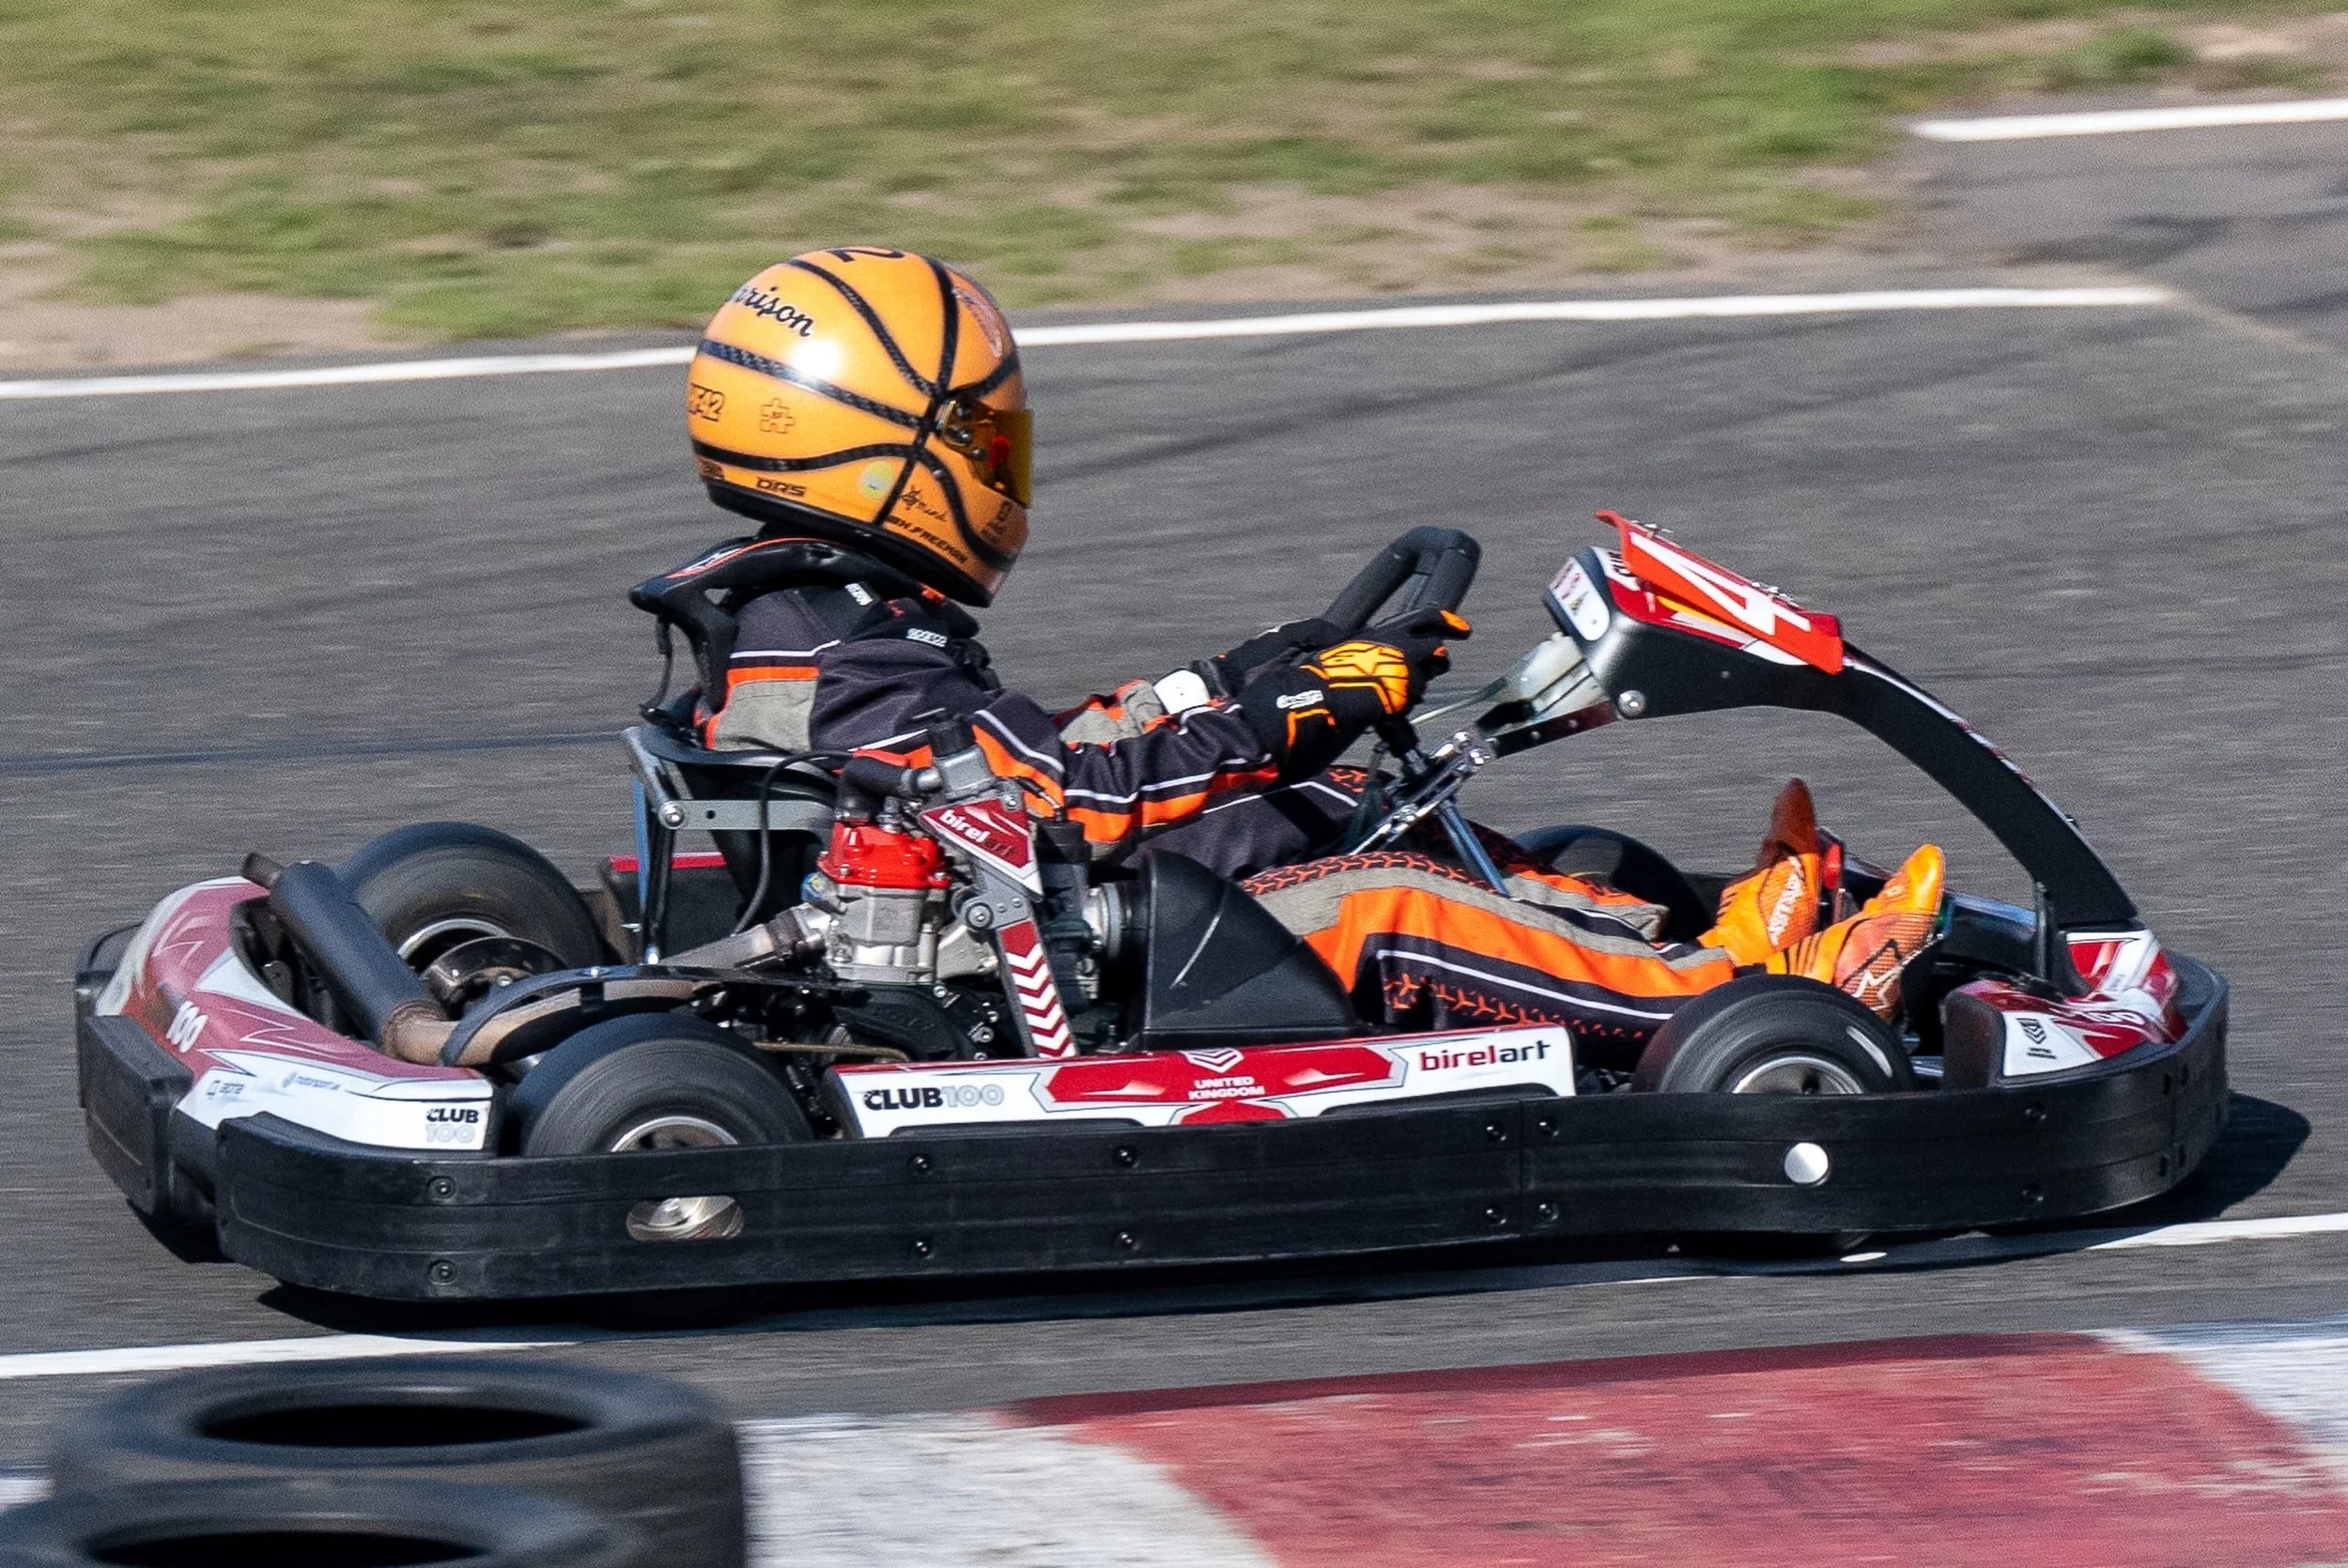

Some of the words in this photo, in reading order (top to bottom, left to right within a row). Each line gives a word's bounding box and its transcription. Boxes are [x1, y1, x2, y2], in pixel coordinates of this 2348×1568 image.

[1629, 531, 1812, 637] 4
[1420, 1040, 1551, 1071] birelart
[1194, 1076, 1255, 1089] UNITED
[1188, 1086, 1265, 1100] KINGDOM
[426, 1108, 479, 1123] CLUB
[425, 1124, 475, 1143] 100
